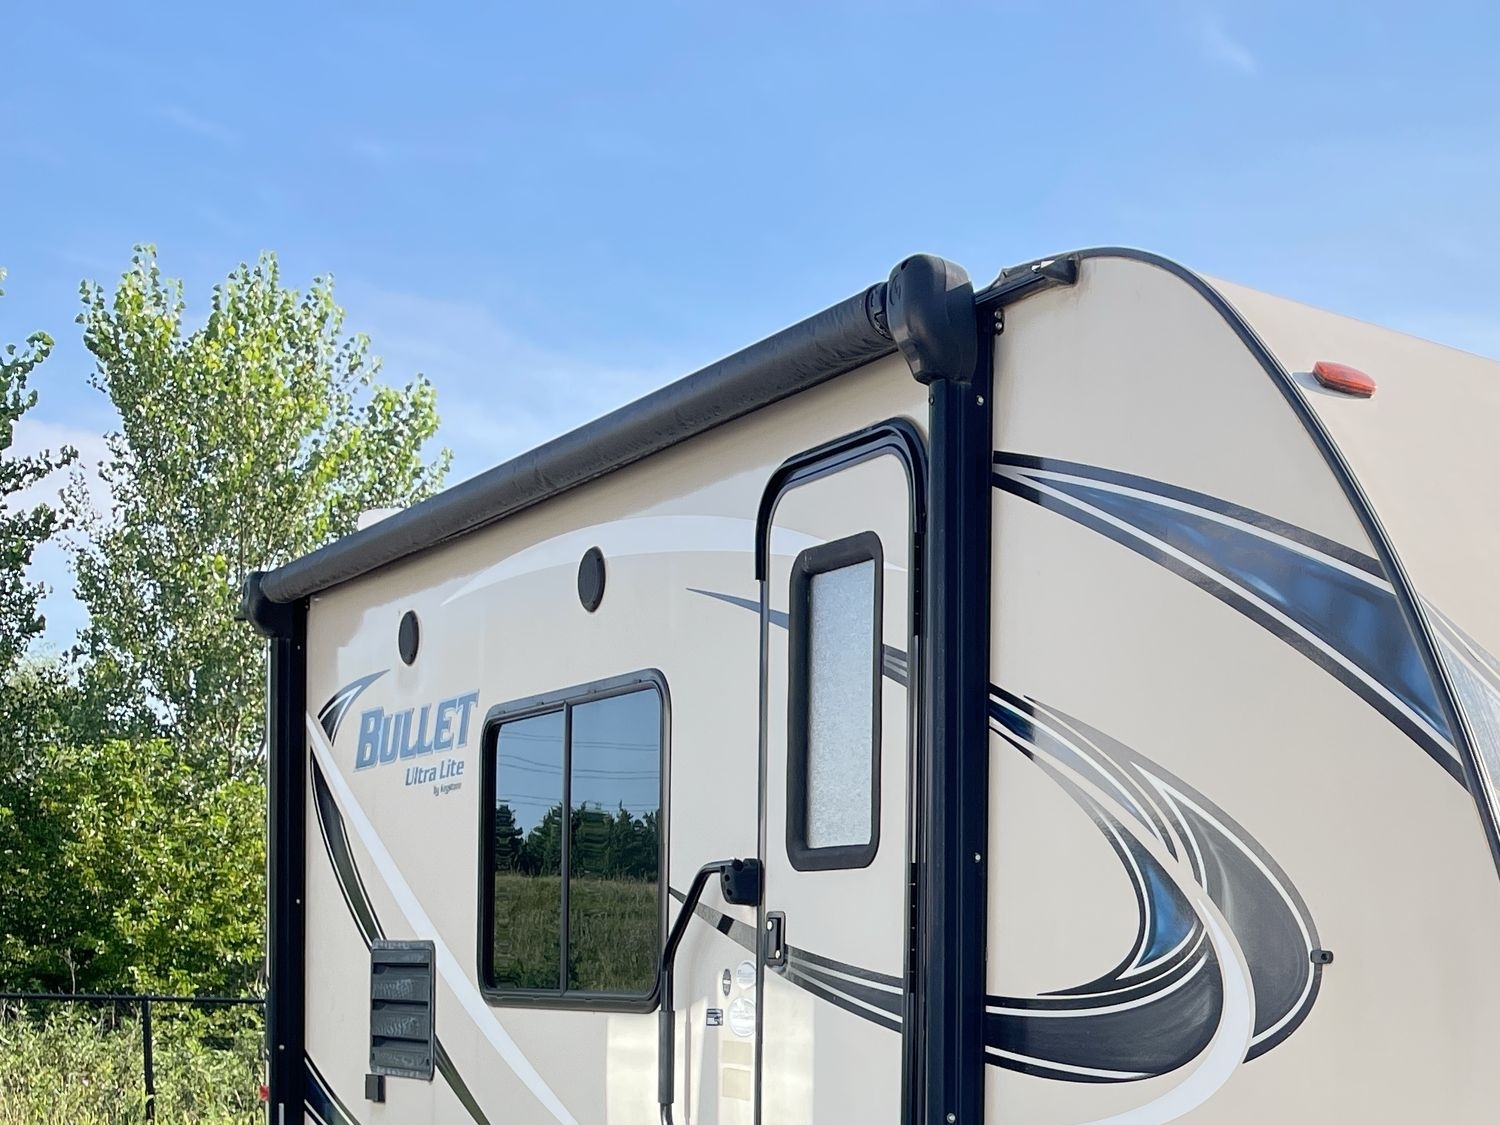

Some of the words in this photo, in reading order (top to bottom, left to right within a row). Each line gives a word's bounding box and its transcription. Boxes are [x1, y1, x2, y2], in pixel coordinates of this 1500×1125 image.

[353, 688, 480, 772] BULLET
[405, 767, 437, 786] Ultra
[439, 759, 464, 779] Lite
